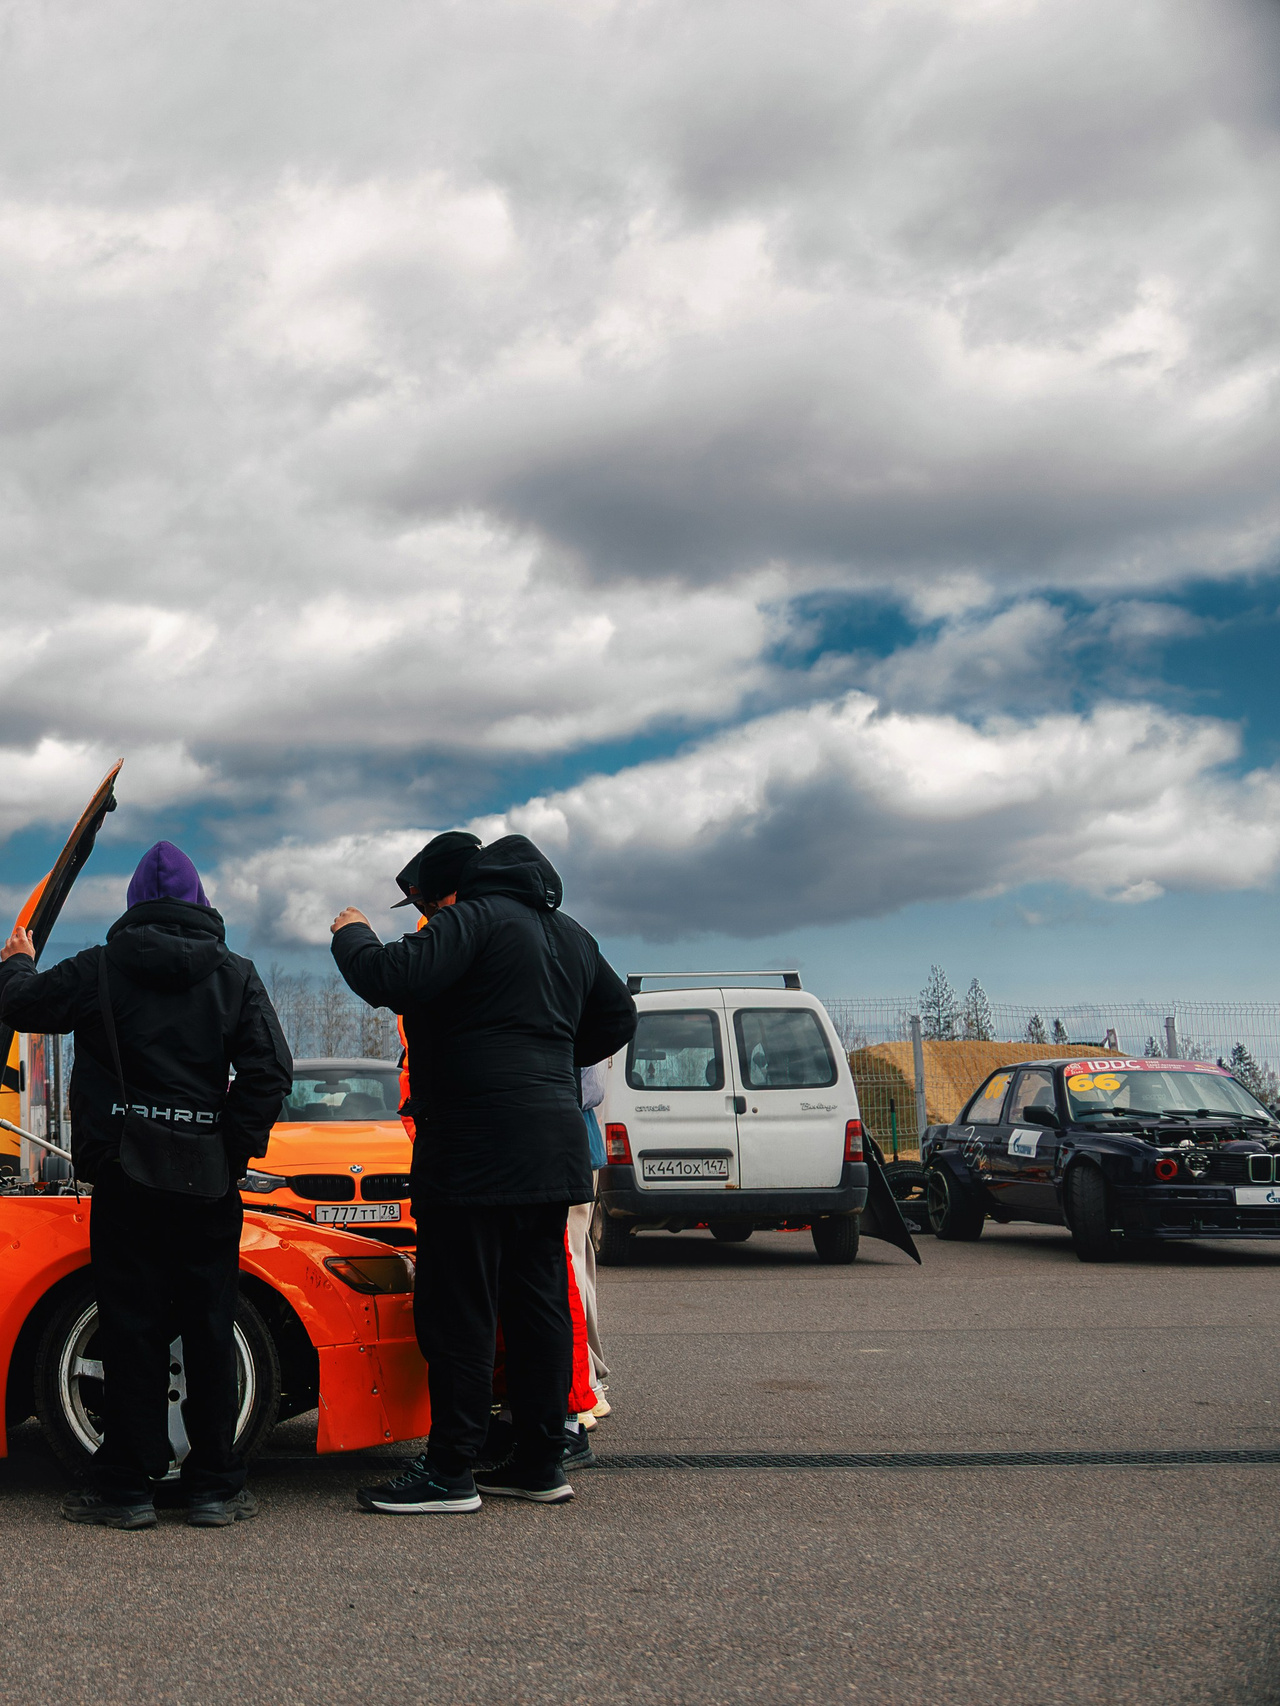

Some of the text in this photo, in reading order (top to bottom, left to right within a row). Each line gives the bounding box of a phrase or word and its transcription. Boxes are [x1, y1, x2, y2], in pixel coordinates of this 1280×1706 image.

[1086, 1059, 1141, 1071] IDDC
[984, 1074, 1010, 1099] 66
[1067, 1073, 1121, 1092] 66
[703, 1160, 724, 1171] 147
[381, 1205, 396, 1216] 78
